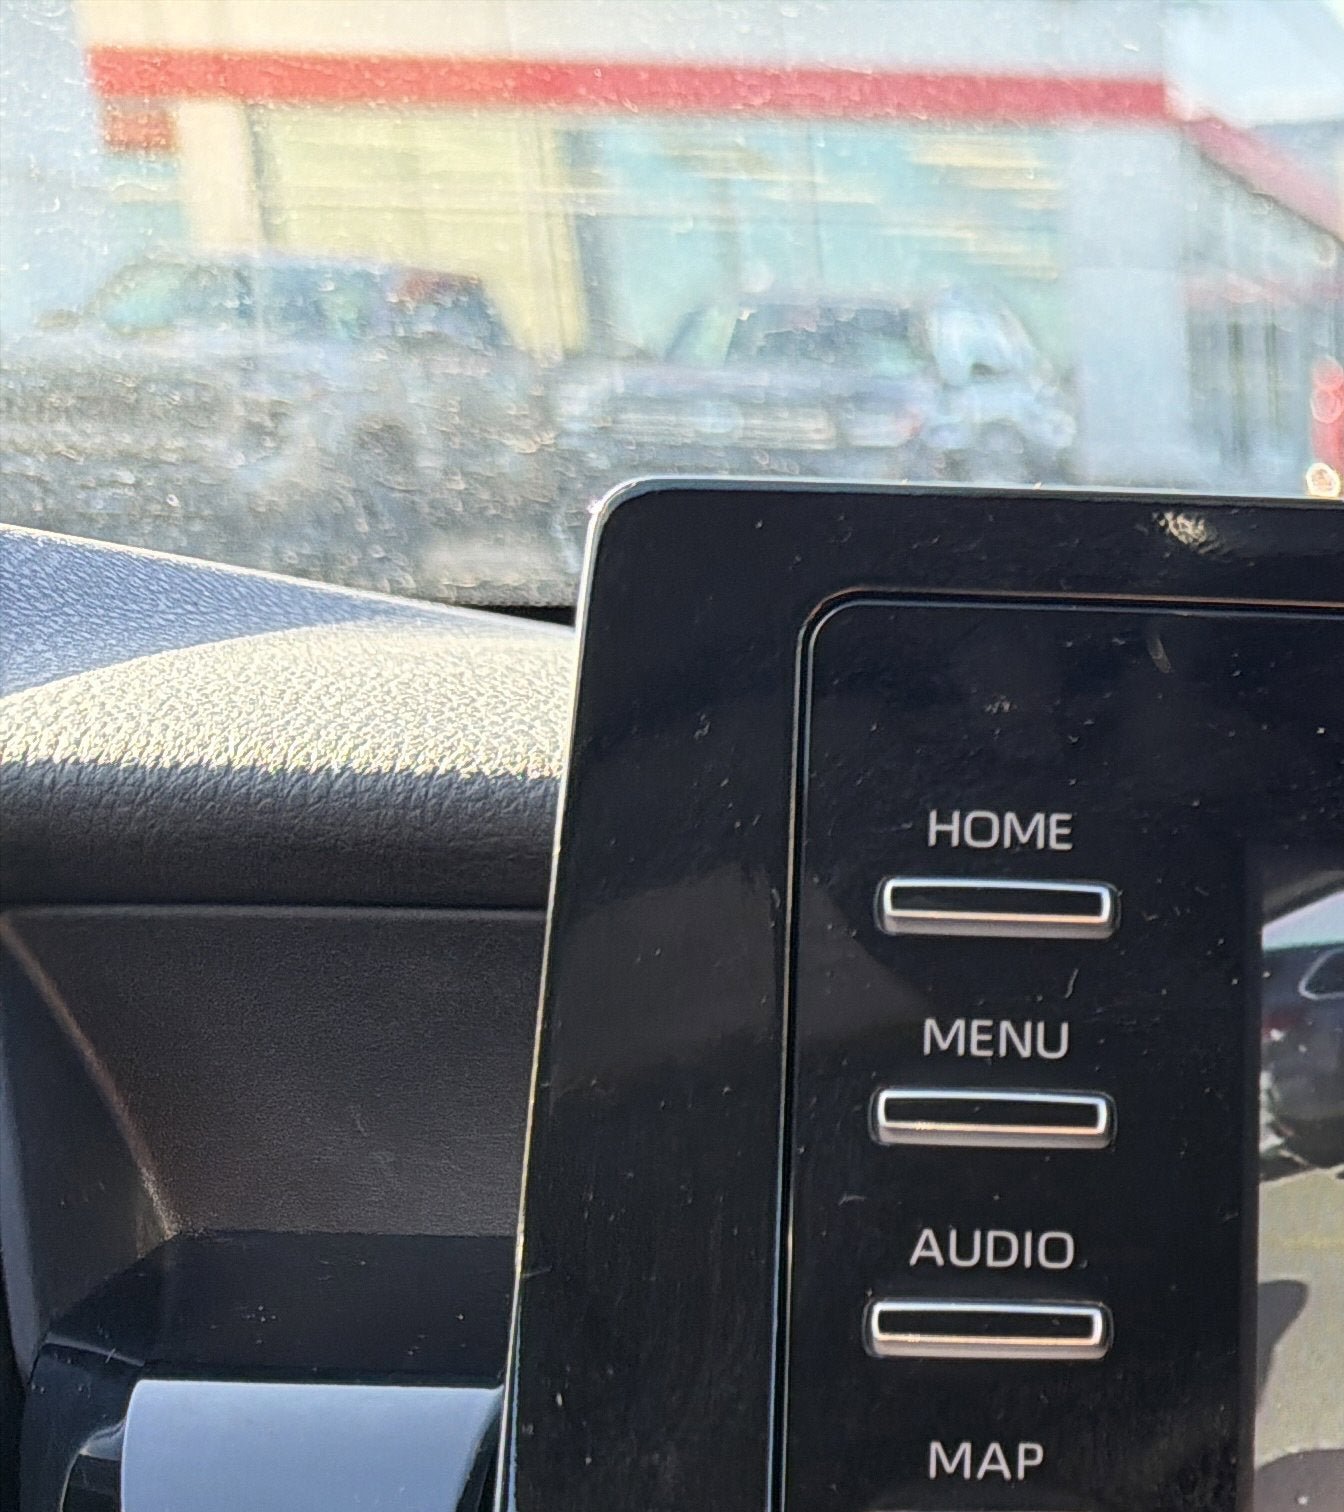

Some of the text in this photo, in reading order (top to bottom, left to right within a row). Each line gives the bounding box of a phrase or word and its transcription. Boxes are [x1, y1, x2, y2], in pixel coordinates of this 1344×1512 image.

[927, 809, 1074, 851] HOME
[923, 1018, 1069, 1059] MENU
[909, 1228, 1075, 1269] AUDIO
[928, 1440, 1044, 1481] MAP
